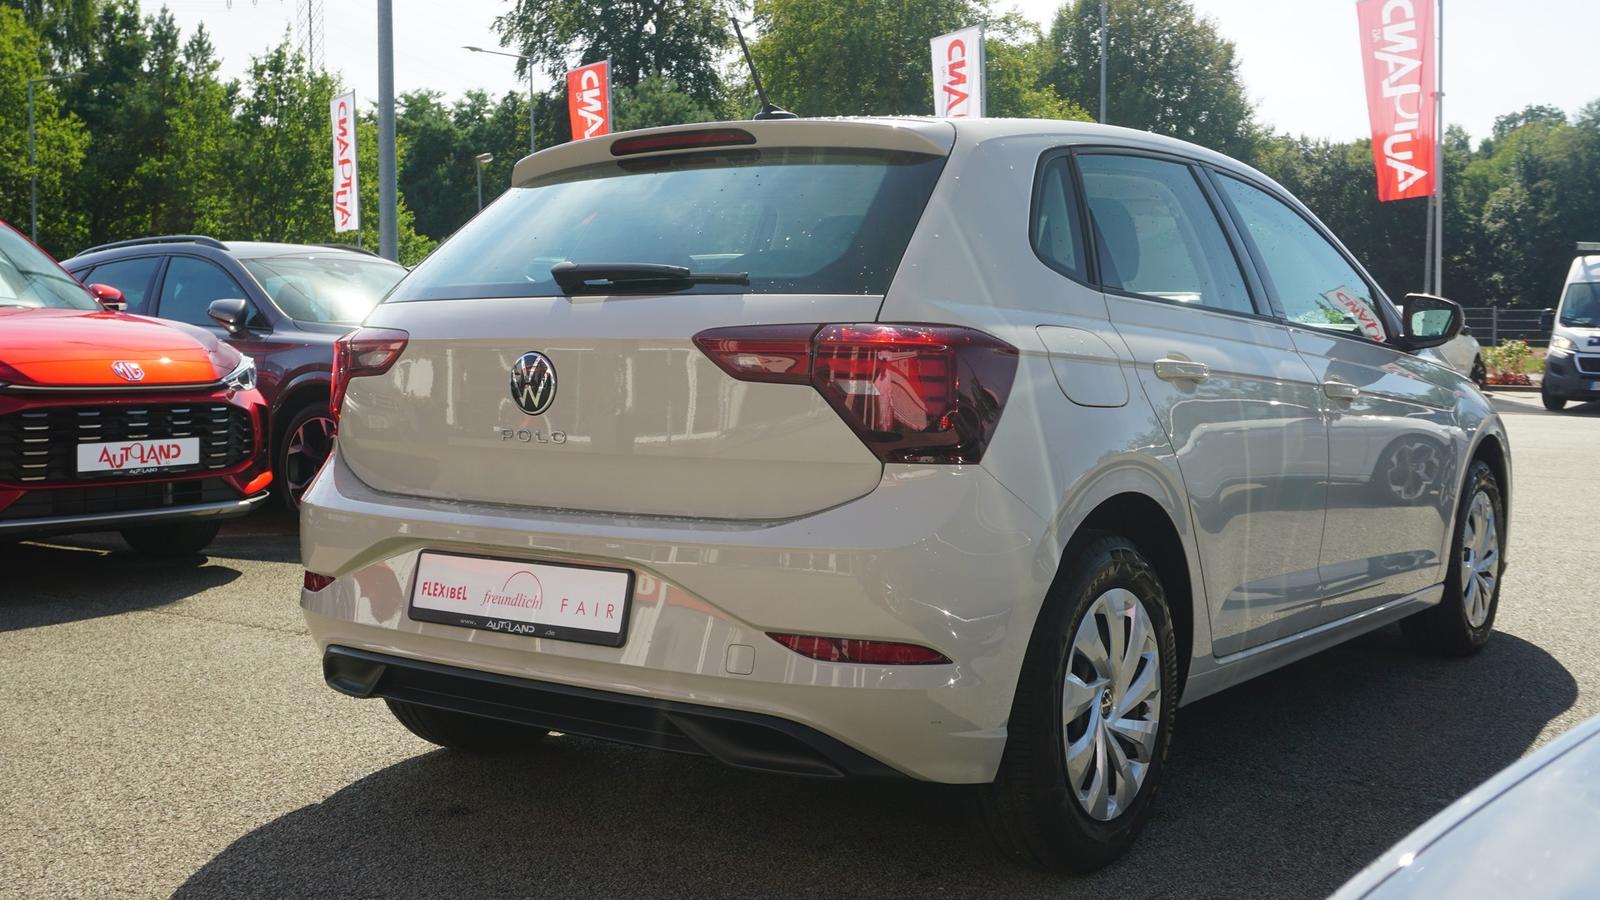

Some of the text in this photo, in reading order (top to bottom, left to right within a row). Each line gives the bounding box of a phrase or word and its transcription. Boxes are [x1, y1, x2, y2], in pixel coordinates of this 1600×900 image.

[112, 360, 144, 381] MG
[501, 428, 568, 444] POLO
[98, 442, 182, 469] AUTOLAND
[128, 467, 158, 475] AUTLAND
[421, 581, 615, 619] FLEXIBEL freundlich FAIR
[486, 620, 536, 634] AUTOLAND
